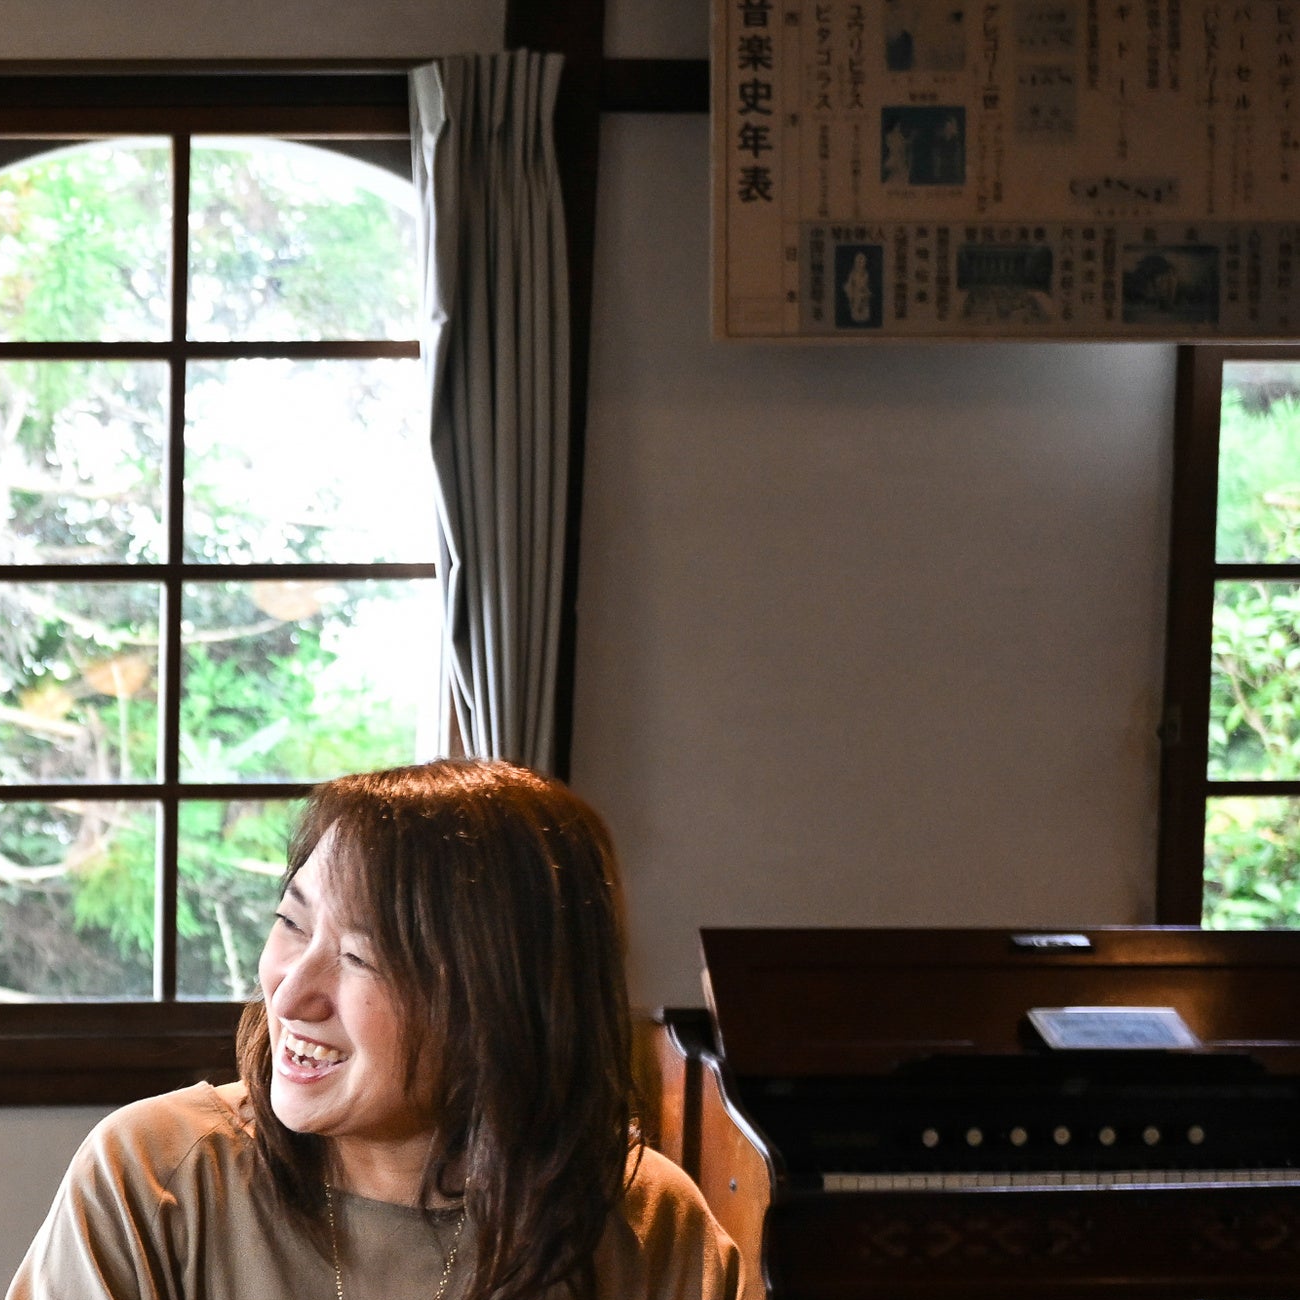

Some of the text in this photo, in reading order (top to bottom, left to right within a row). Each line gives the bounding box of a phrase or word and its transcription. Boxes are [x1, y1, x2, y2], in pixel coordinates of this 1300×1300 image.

[736, 0, 774, 204] 音楽史年表
